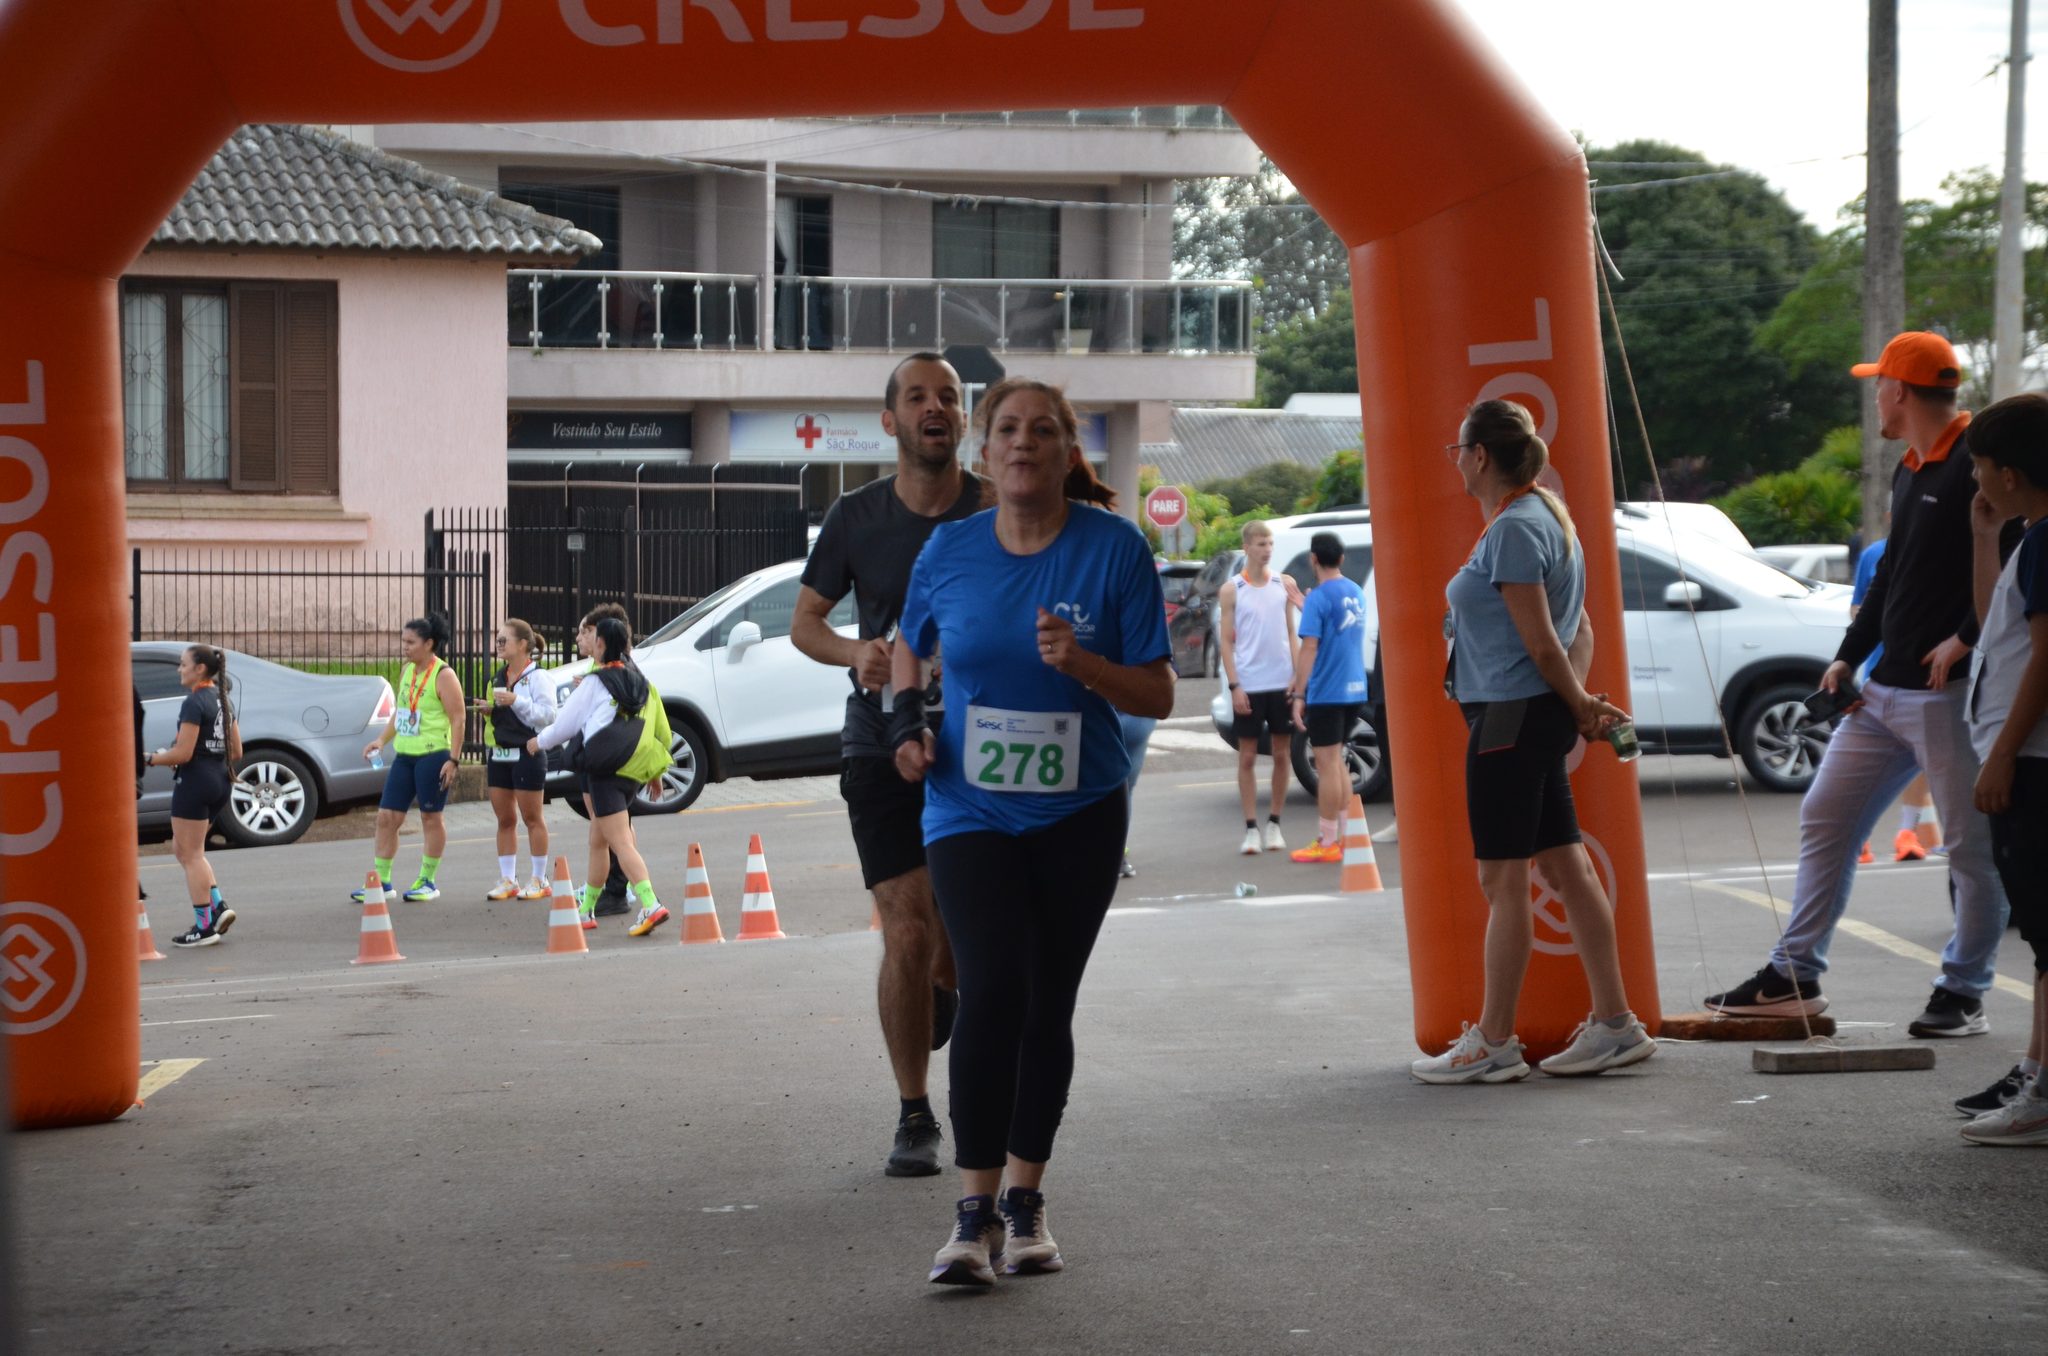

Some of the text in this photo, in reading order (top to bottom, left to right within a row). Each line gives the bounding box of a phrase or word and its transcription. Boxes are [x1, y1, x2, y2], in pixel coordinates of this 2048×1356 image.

[552, 421, 662, 438] Vestindo Seu Estilo
[827, 438, 880, 451] São Roque
[1152, 499, 1180, 513] PARE
[0, 359, 63, 857] CRESOL
[977, 740, 1065, 786] 278
[186, 932, 201, 943] FILA
